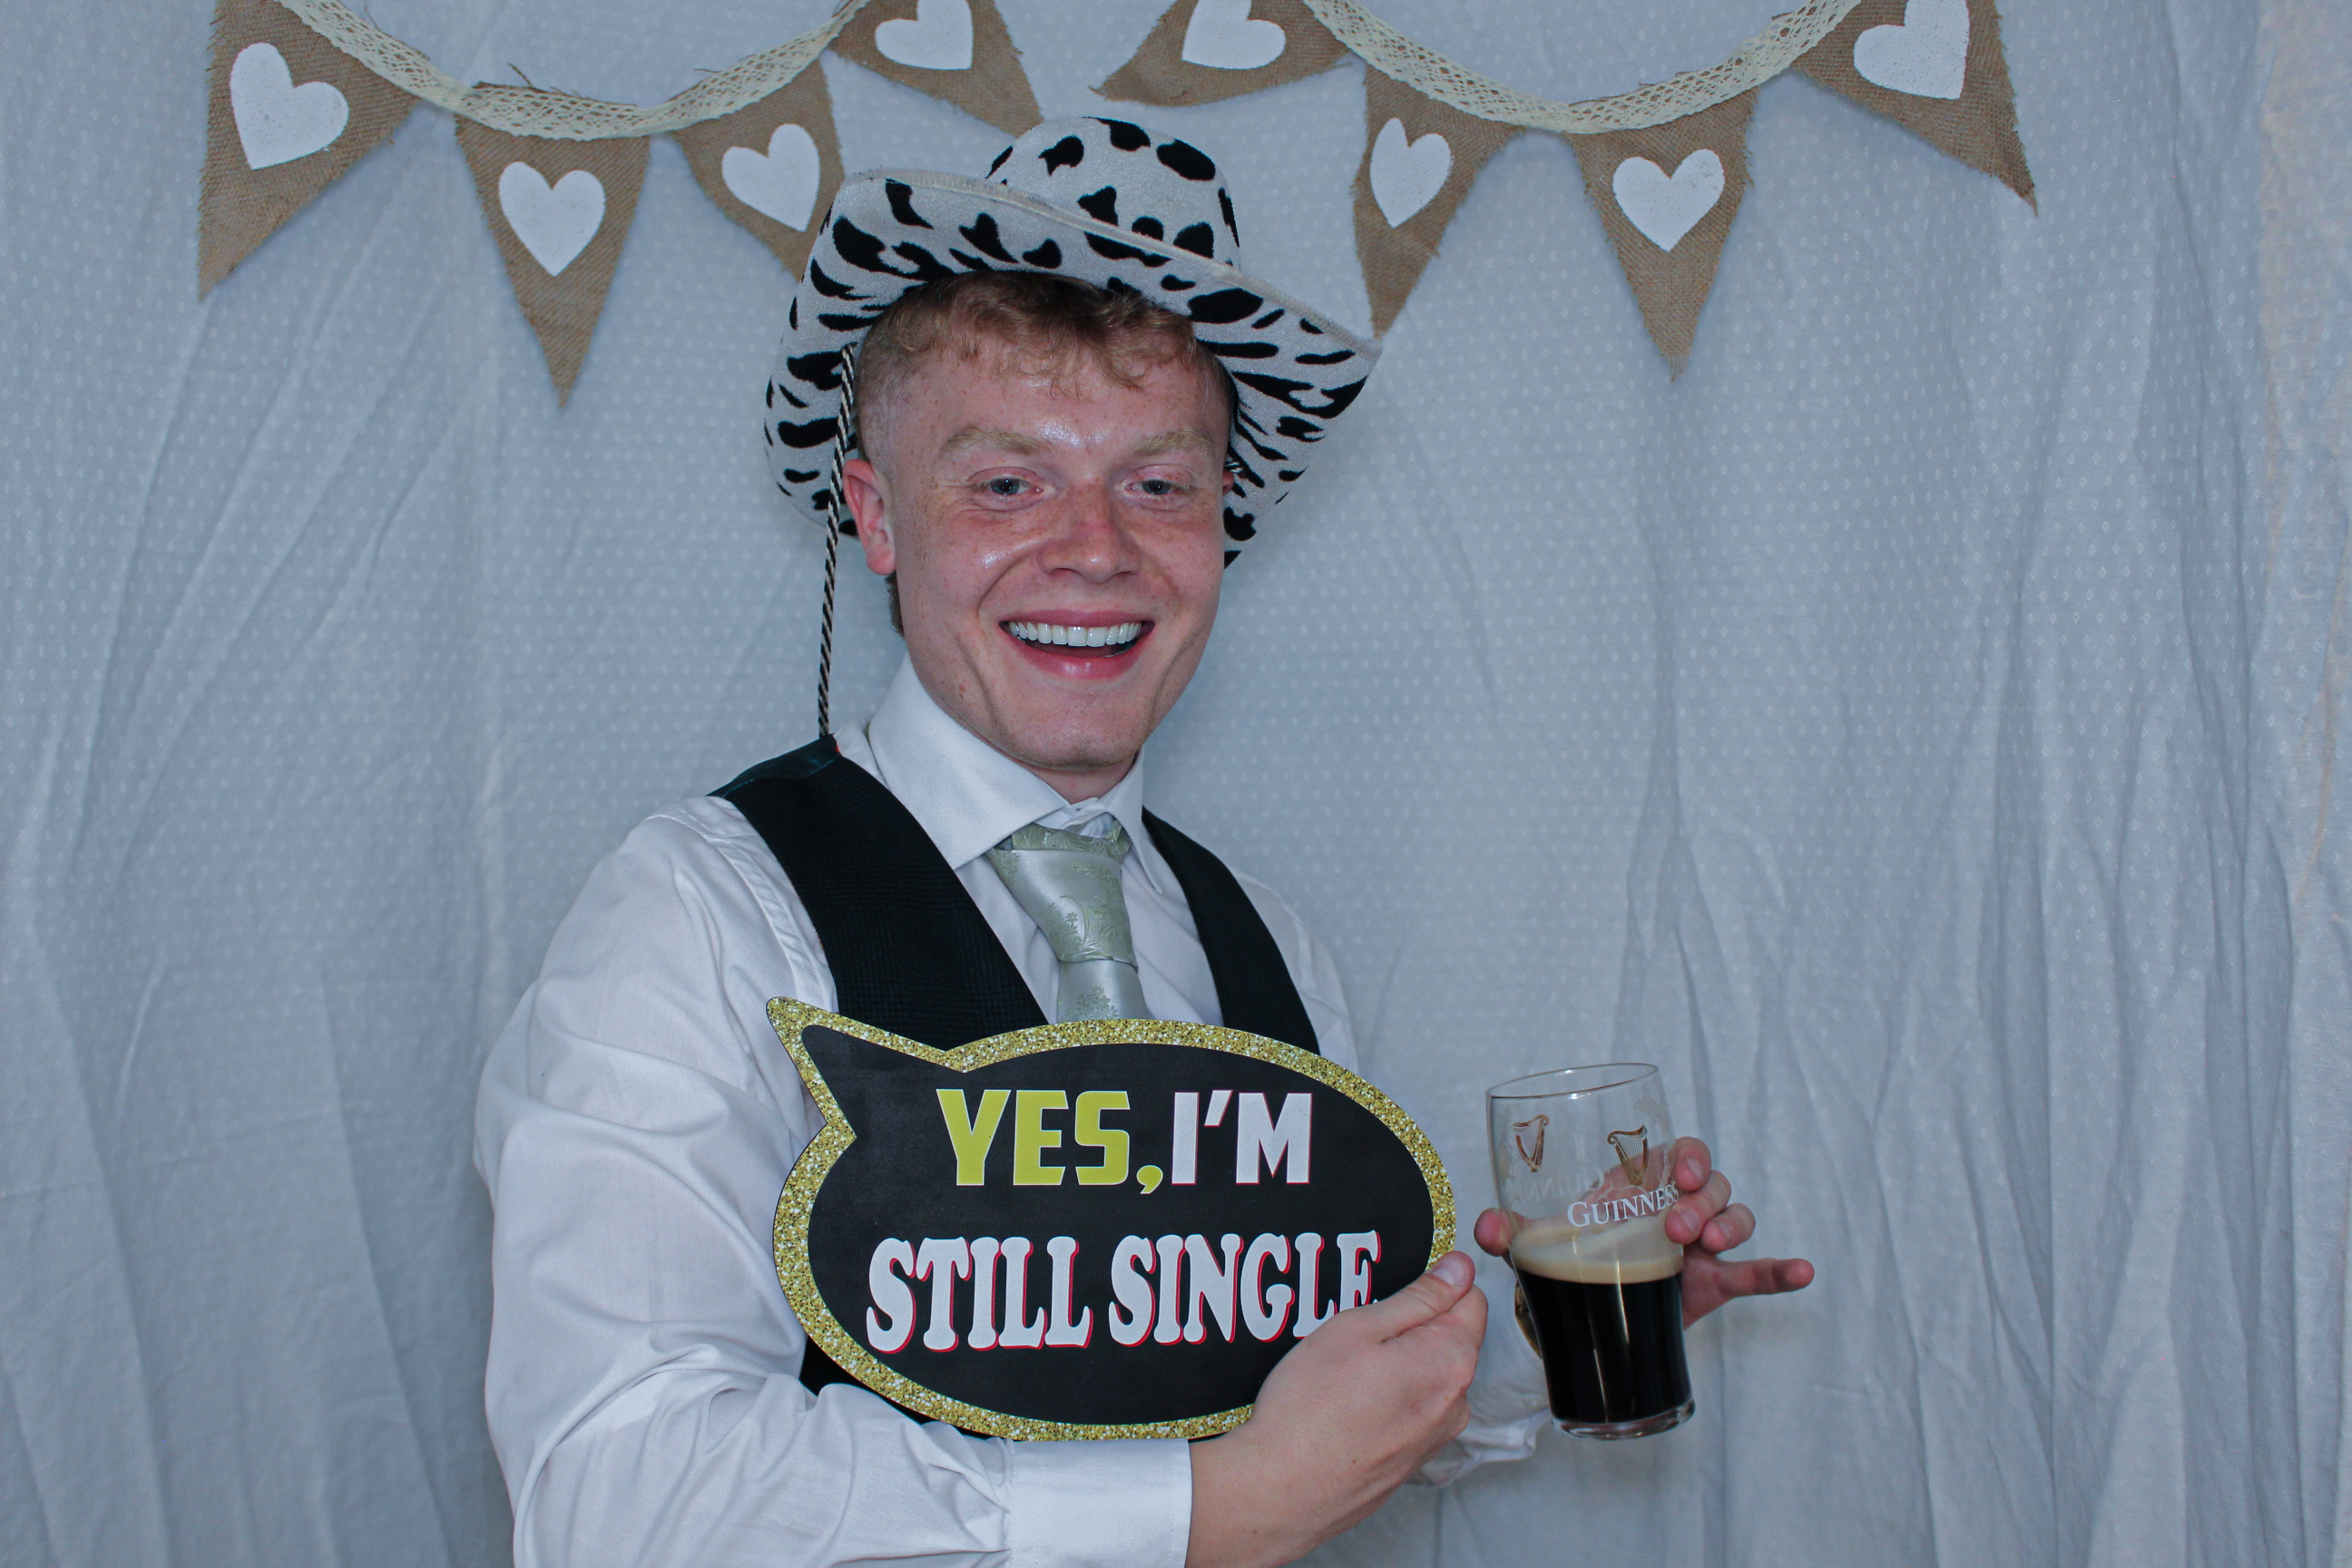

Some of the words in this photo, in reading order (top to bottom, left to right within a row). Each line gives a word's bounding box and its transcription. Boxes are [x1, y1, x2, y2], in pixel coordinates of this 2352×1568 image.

[936, 1089, 1163, 1194] YES,
[1171, 1091, 1313, 1184] I'M
[1567, 1181, 1680, 1227] GUINNESS
[867, 1237, 1093, 1353] STILL
[1109, 1230, 1382, 1344] SINGLE
